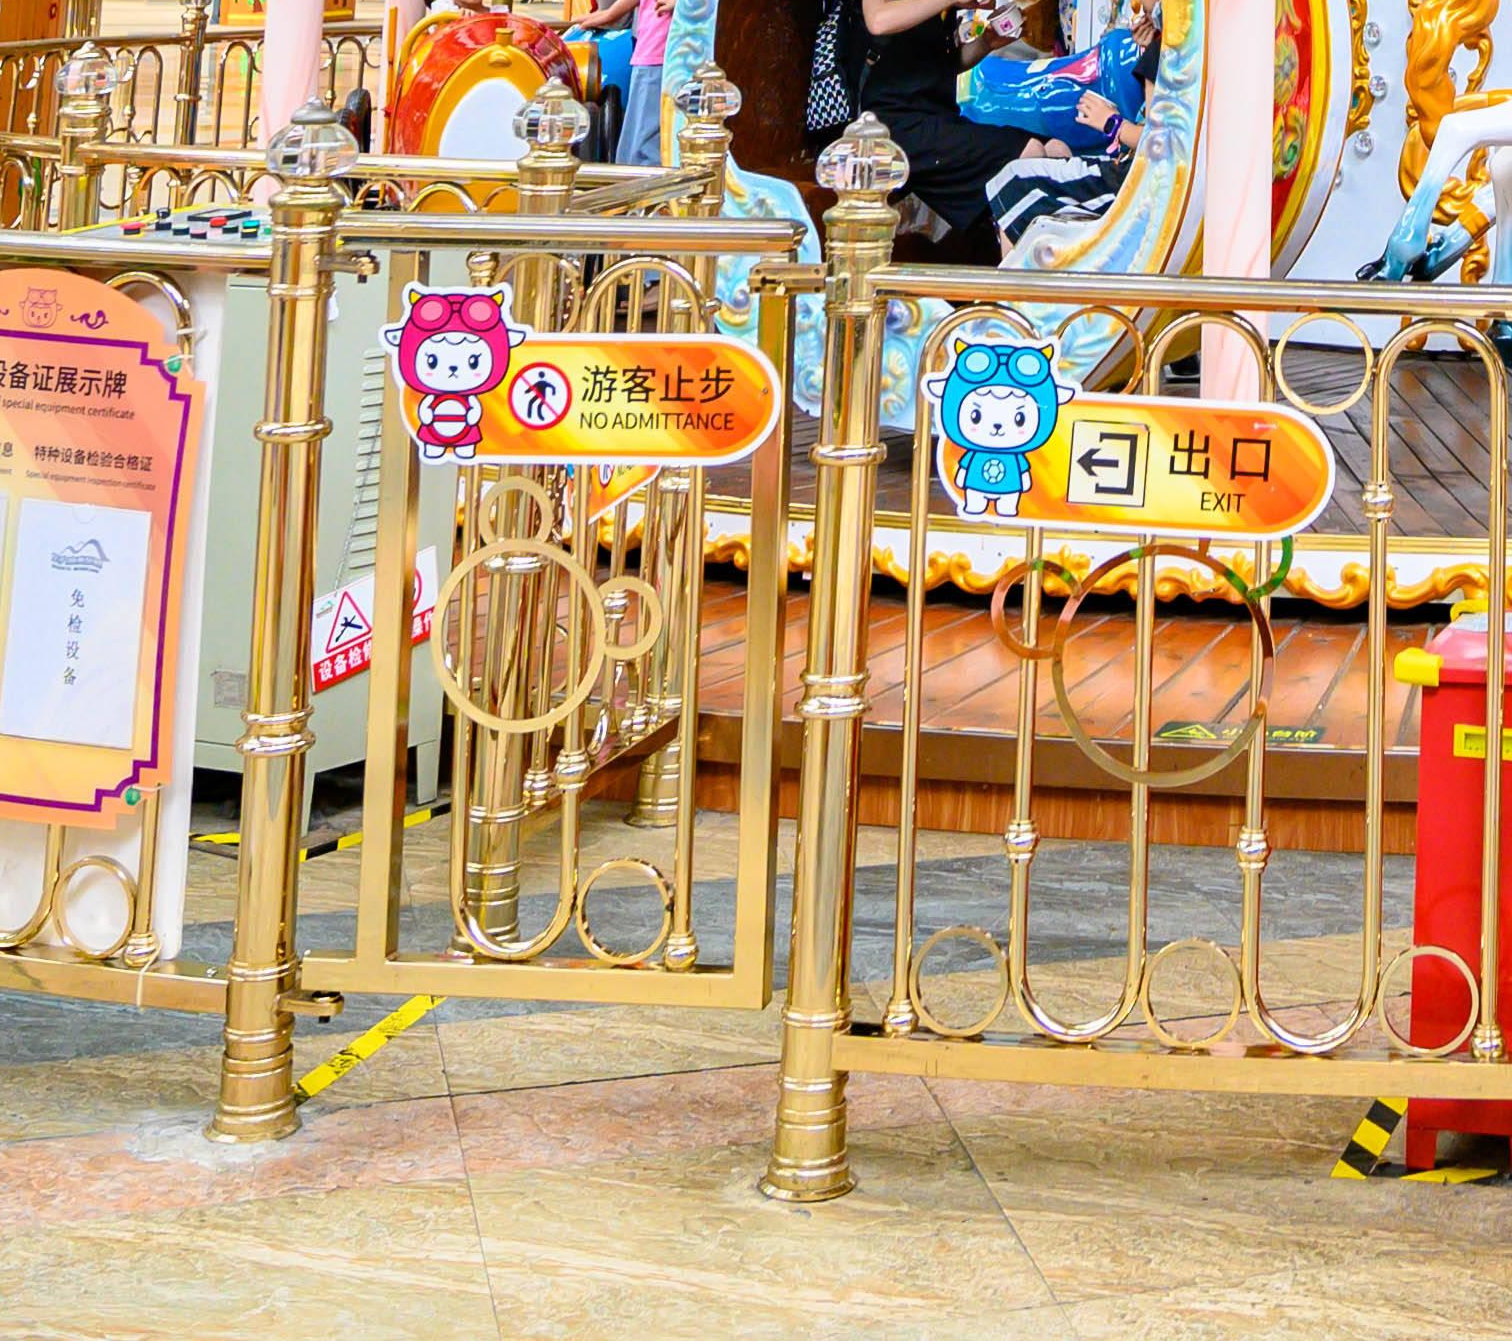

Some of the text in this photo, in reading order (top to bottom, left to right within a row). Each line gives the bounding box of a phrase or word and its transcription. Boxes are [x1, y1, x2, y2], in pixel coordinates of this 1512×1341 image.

[580, 365, 735, 404] 游客止步
[1, 397, 34, 413] special
[35, 401, 86, 416] equipment
[87, 405, 135, 420] certificate
[580, 412, 735, 431] NO ADMITTANCE
[34, 445, 153, 471] 特种设备检验合格证
[1168, 429, 1272, 483] 出口
[1200, 490, 1246, 514] EXIT
[62, 588, 86, 686] 免检设备
